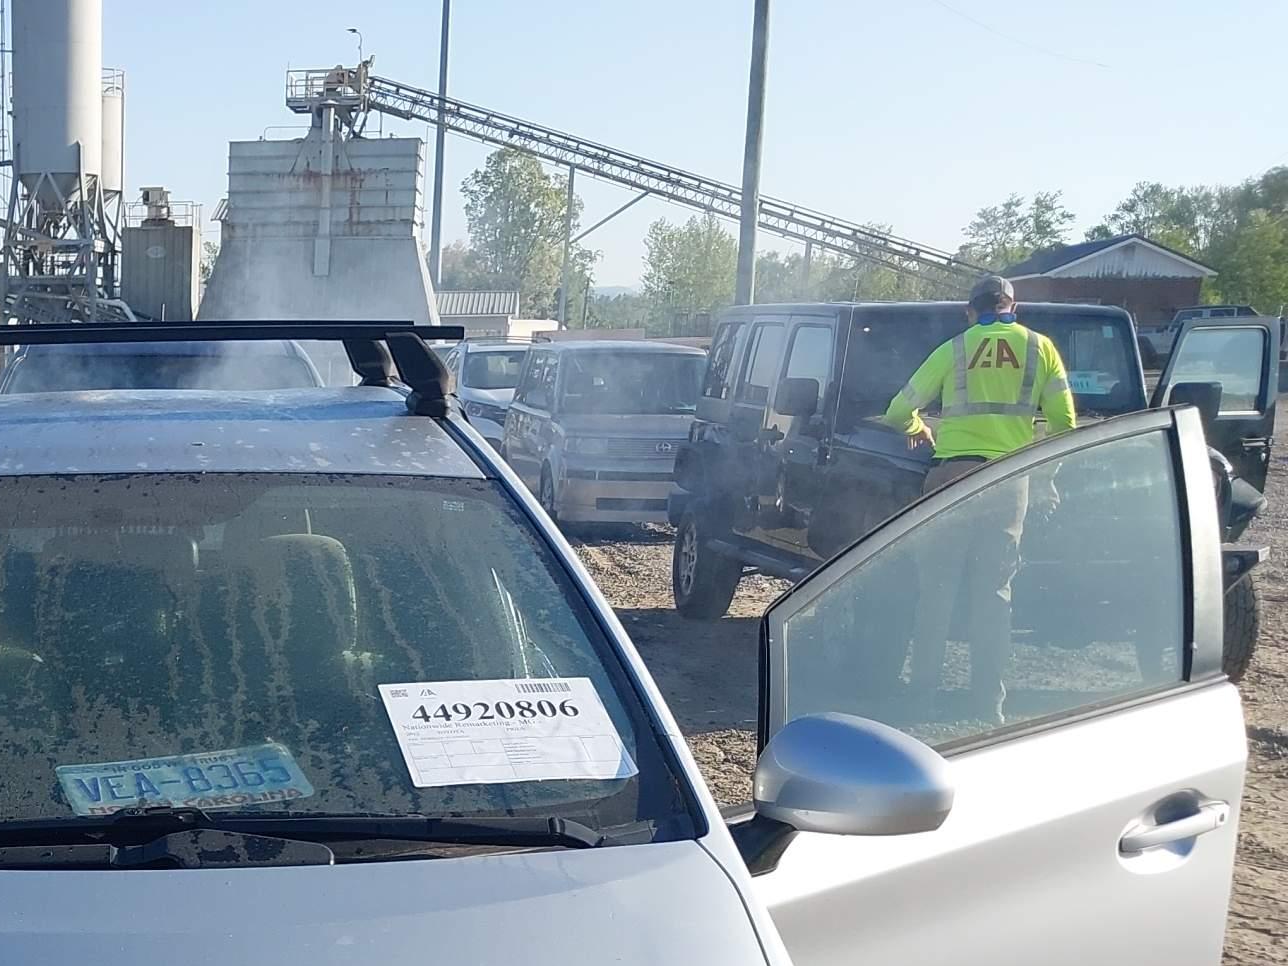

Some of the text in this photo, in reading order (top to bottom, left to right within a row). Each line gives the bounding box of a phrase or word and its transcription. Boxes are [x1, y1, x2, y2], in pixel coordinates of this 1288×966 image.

[412, 699, 580, 722] 44920806
[454, 719, 511, 730] Remarketing
[71, 758, 292, 802] VEA-8365
